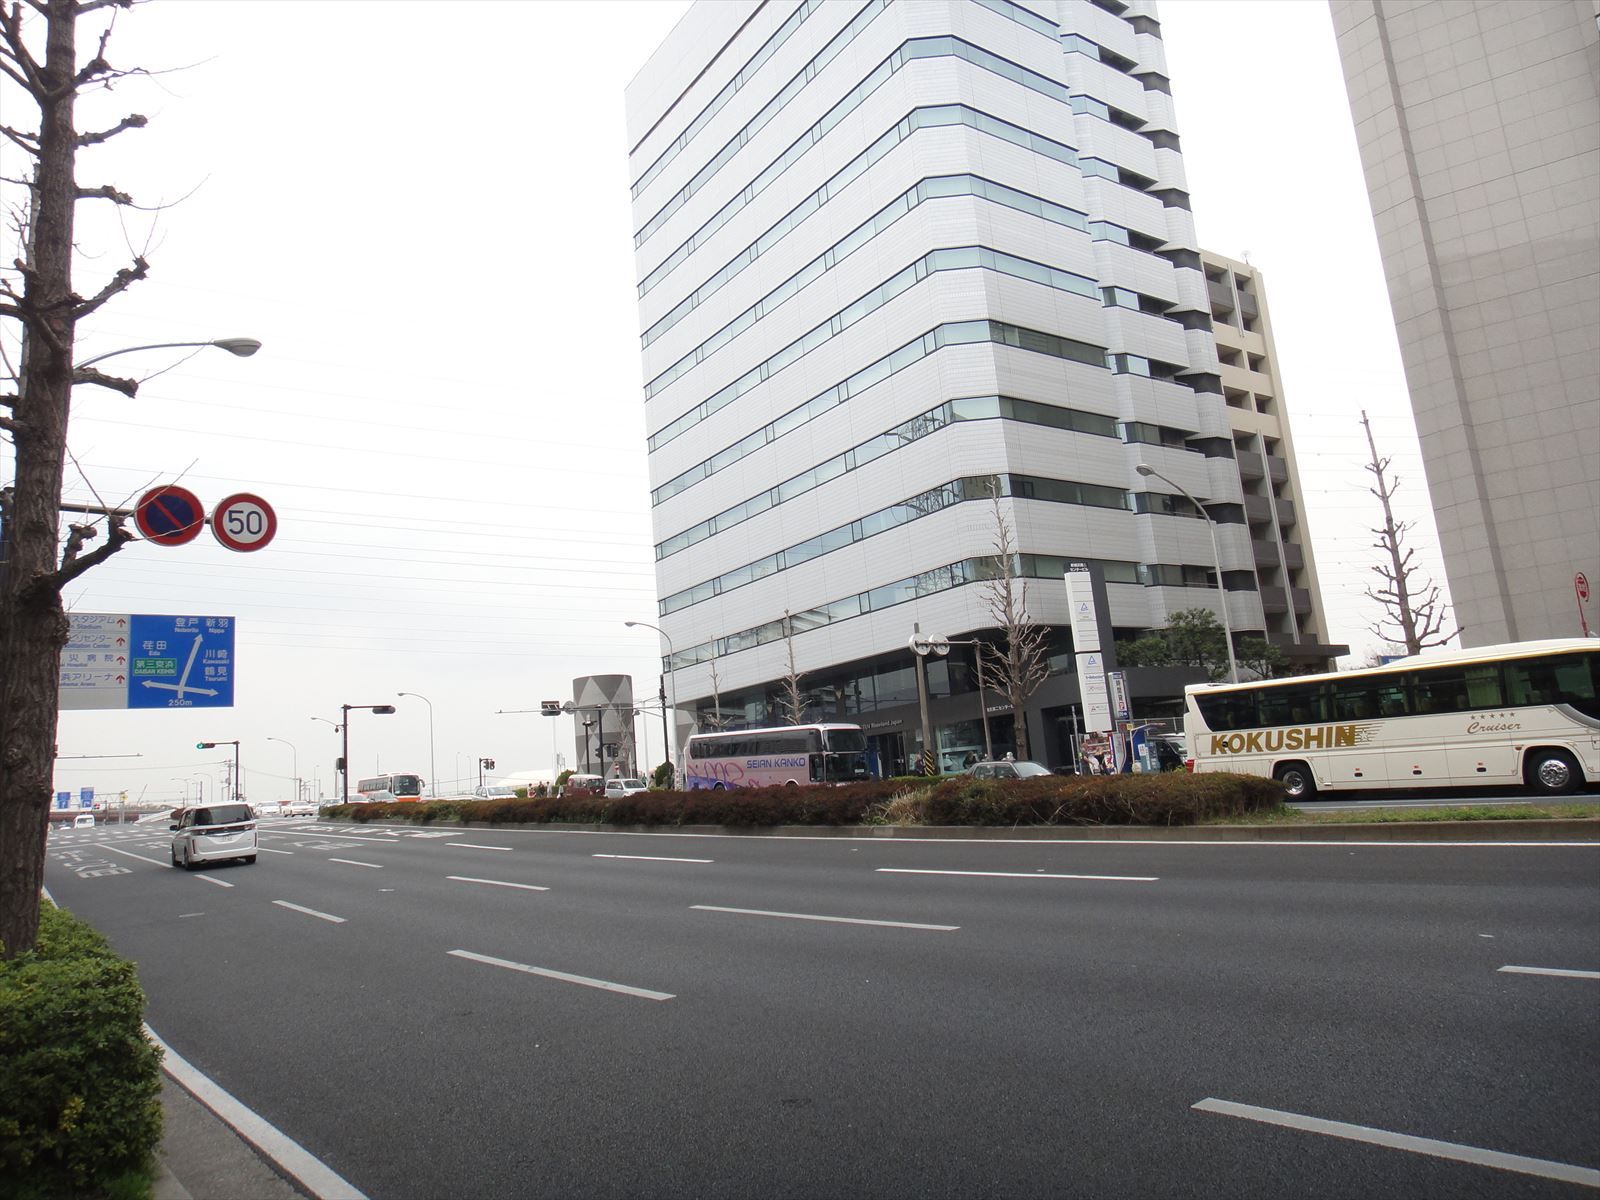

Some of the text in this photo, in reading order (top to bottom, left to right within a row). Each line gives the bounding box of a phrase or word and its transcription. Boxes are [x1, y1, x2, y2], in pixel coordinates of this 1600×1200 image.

[228, 509, 262, 535] 50
[175, 617, 198, 627] 登戸
[206, 618, 229, 628] 新羽
[205, 649, 228, 658] 川崎
[168, 699, 193, 707] 250m
[1467, 722, 1522, 734] Cruiser
[1210, 724, 1357, 755] KOKUSHIN
[746, 757, 806, 769] SEIAN KANKO
